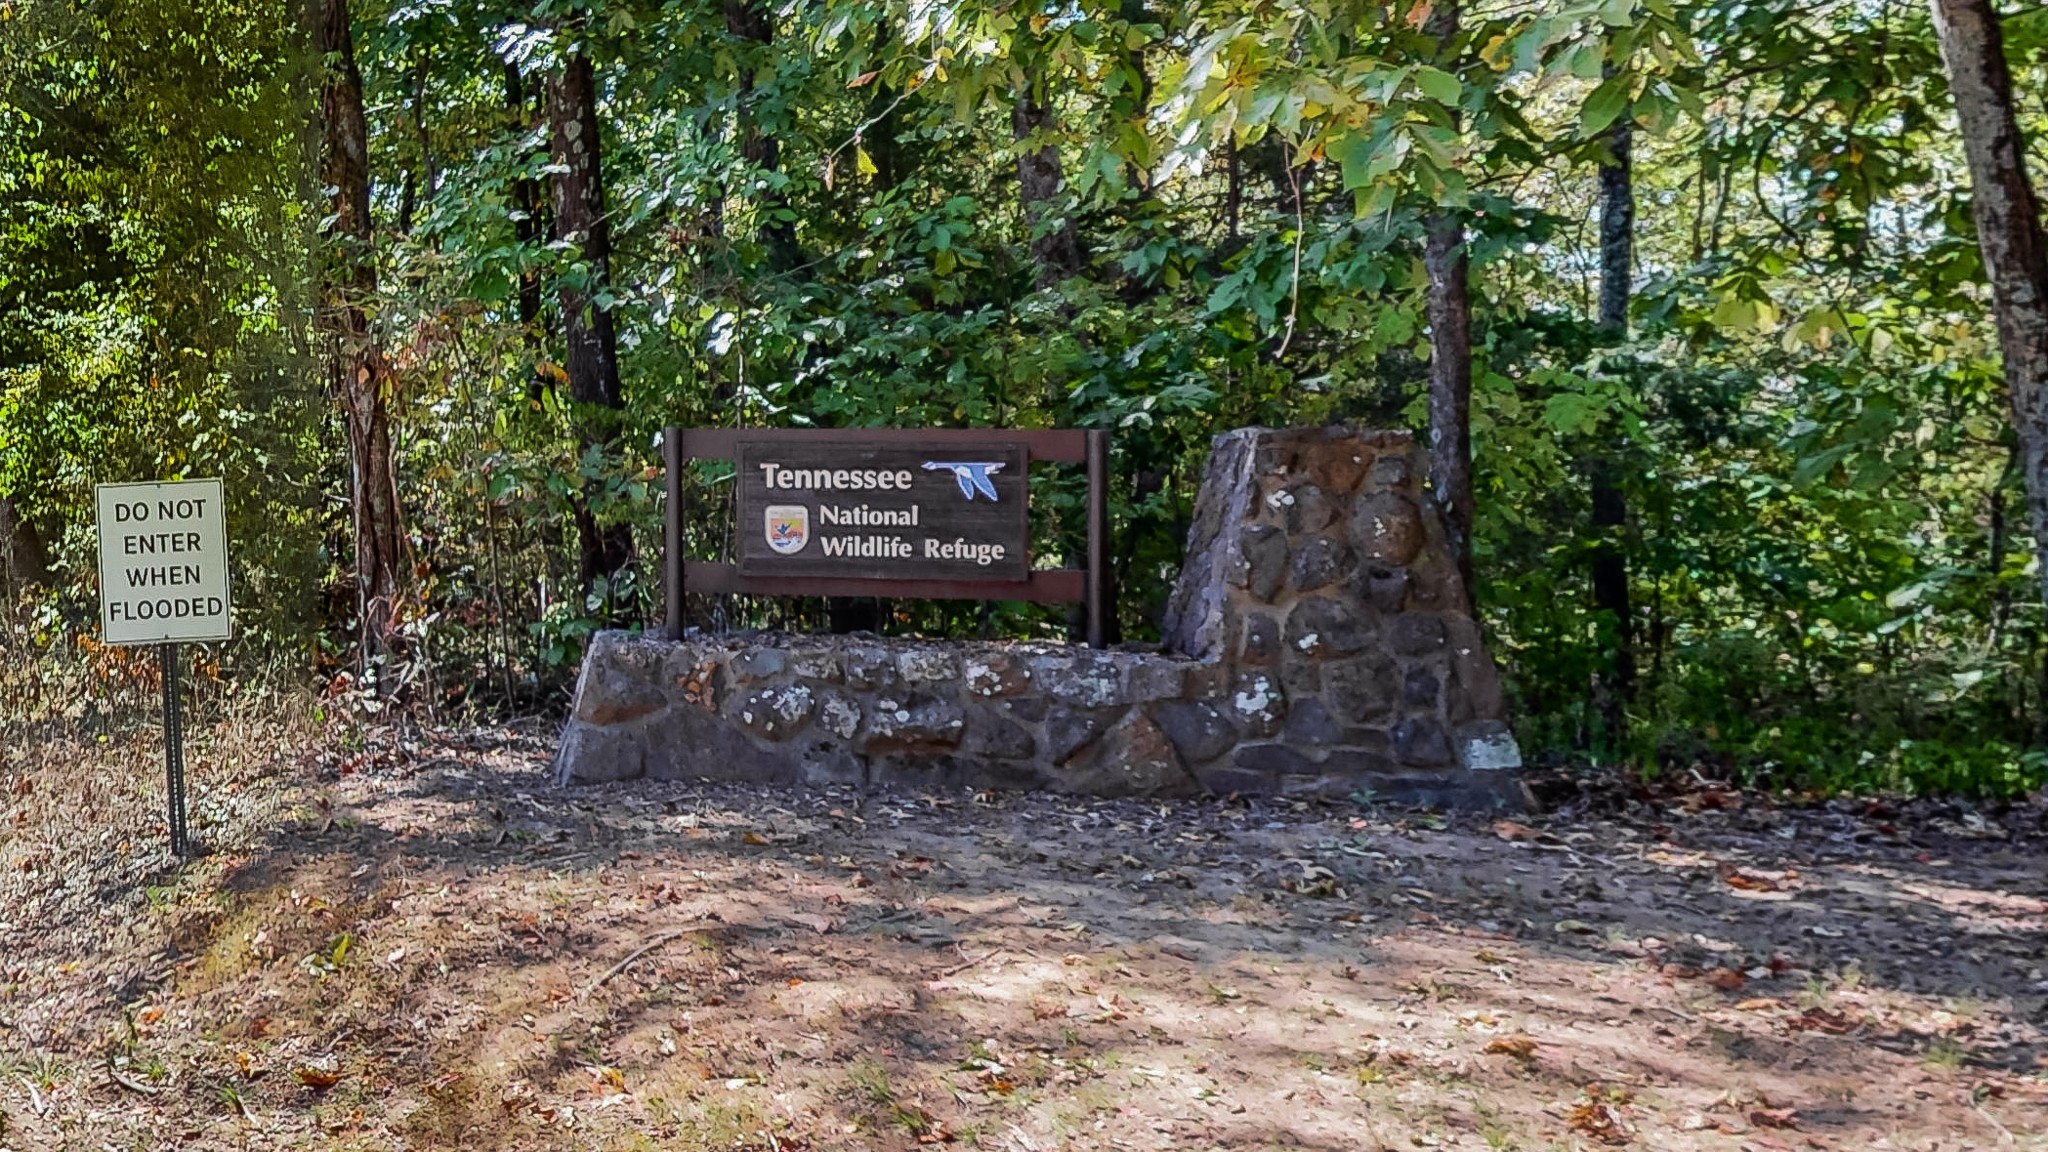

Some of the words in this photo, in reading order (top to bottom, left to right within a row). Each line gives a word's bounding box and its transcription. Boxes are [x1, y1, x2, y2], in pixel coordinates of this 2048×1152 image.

[760, 463, 913, 489] Tennessee
[115, 502, 149, 522] DO
[158, 499, 206, 520] NOT
[820, 504, 919, 526] National
[124, 532, 202, 555] ENTER
[820, 535, 913, 558] Wildlife
[924, 538, 1005, 565] Refuge
[126, 565, 201, 587] WHEN
[110, 597, 222, 621] FLOODED
